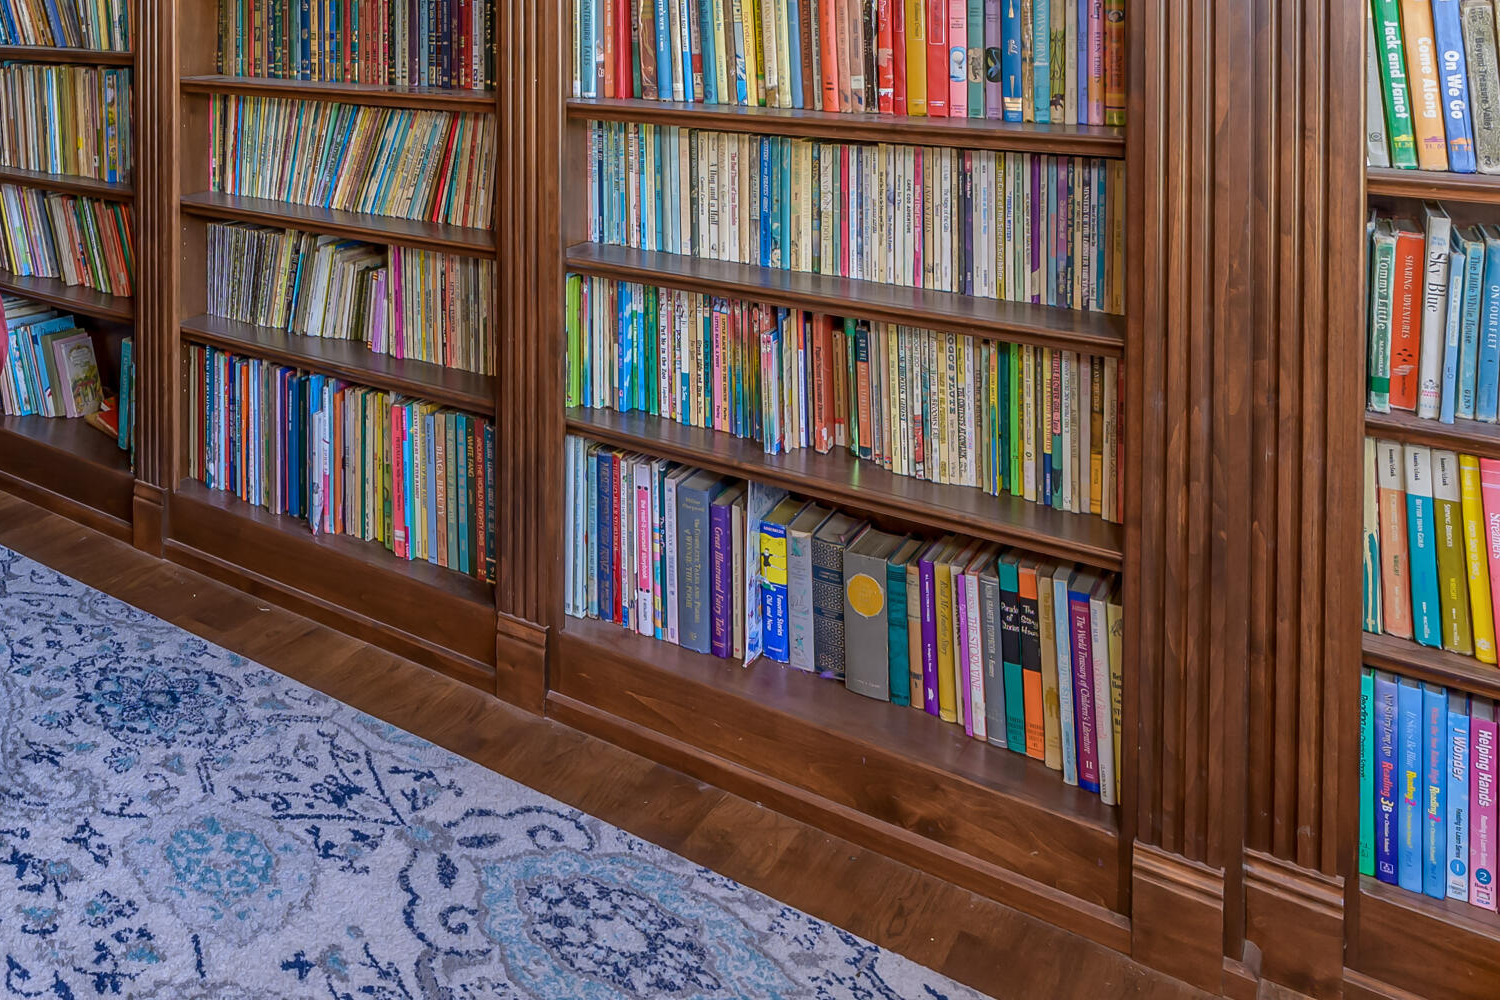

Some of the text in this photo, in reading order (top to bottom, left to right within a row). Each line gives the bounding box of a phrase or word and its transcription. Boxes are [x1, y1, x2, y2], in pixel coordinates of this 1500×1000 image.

[584, 45, 592, 66] TALES
[1384, 20, 1408, 118] Jack and Janet
[1417, 36, 1438, 119] Come Along
[1443, 50, 1465, 119] On We Go
[1474, 37, 1493, 131] Beyond Treasure Valley
[1425, 251, 1449, 313] Sky Blue
[1468, 270, 1480, 291] Little
[1470, 255, 1480, 271] The
[1376, 255, 1391, 330] Tommy Little
[1401, 255, 1414, 339] SHARING ADVENTURES
[1464, 320, 1476, 344] House
[1487, 284, 1500, 350] ON FOUR FEET
[437, 480, 445, 517] BEAUTY
[1490, 512, 1500, 559] Streamers
[715, 550, 723, 592] Illustrated
[714, 594, 724, 614] Fairy
[1024, 604, 1035, 615] The
[716, 618, 724, 637] Tales
[777, 618, 785, 636] Stories
[968, 617, 980, 691] THE STORY VINE
[1076, 616, 1092, 754] The World Treasury of Children's Literature
[1452, 736, 1466, 781] Wonder
[1475, 729, 1492, 770] Helping
[1478, 771, 1492, 807] Hands
[1479, 871, 1488, 882] 2
